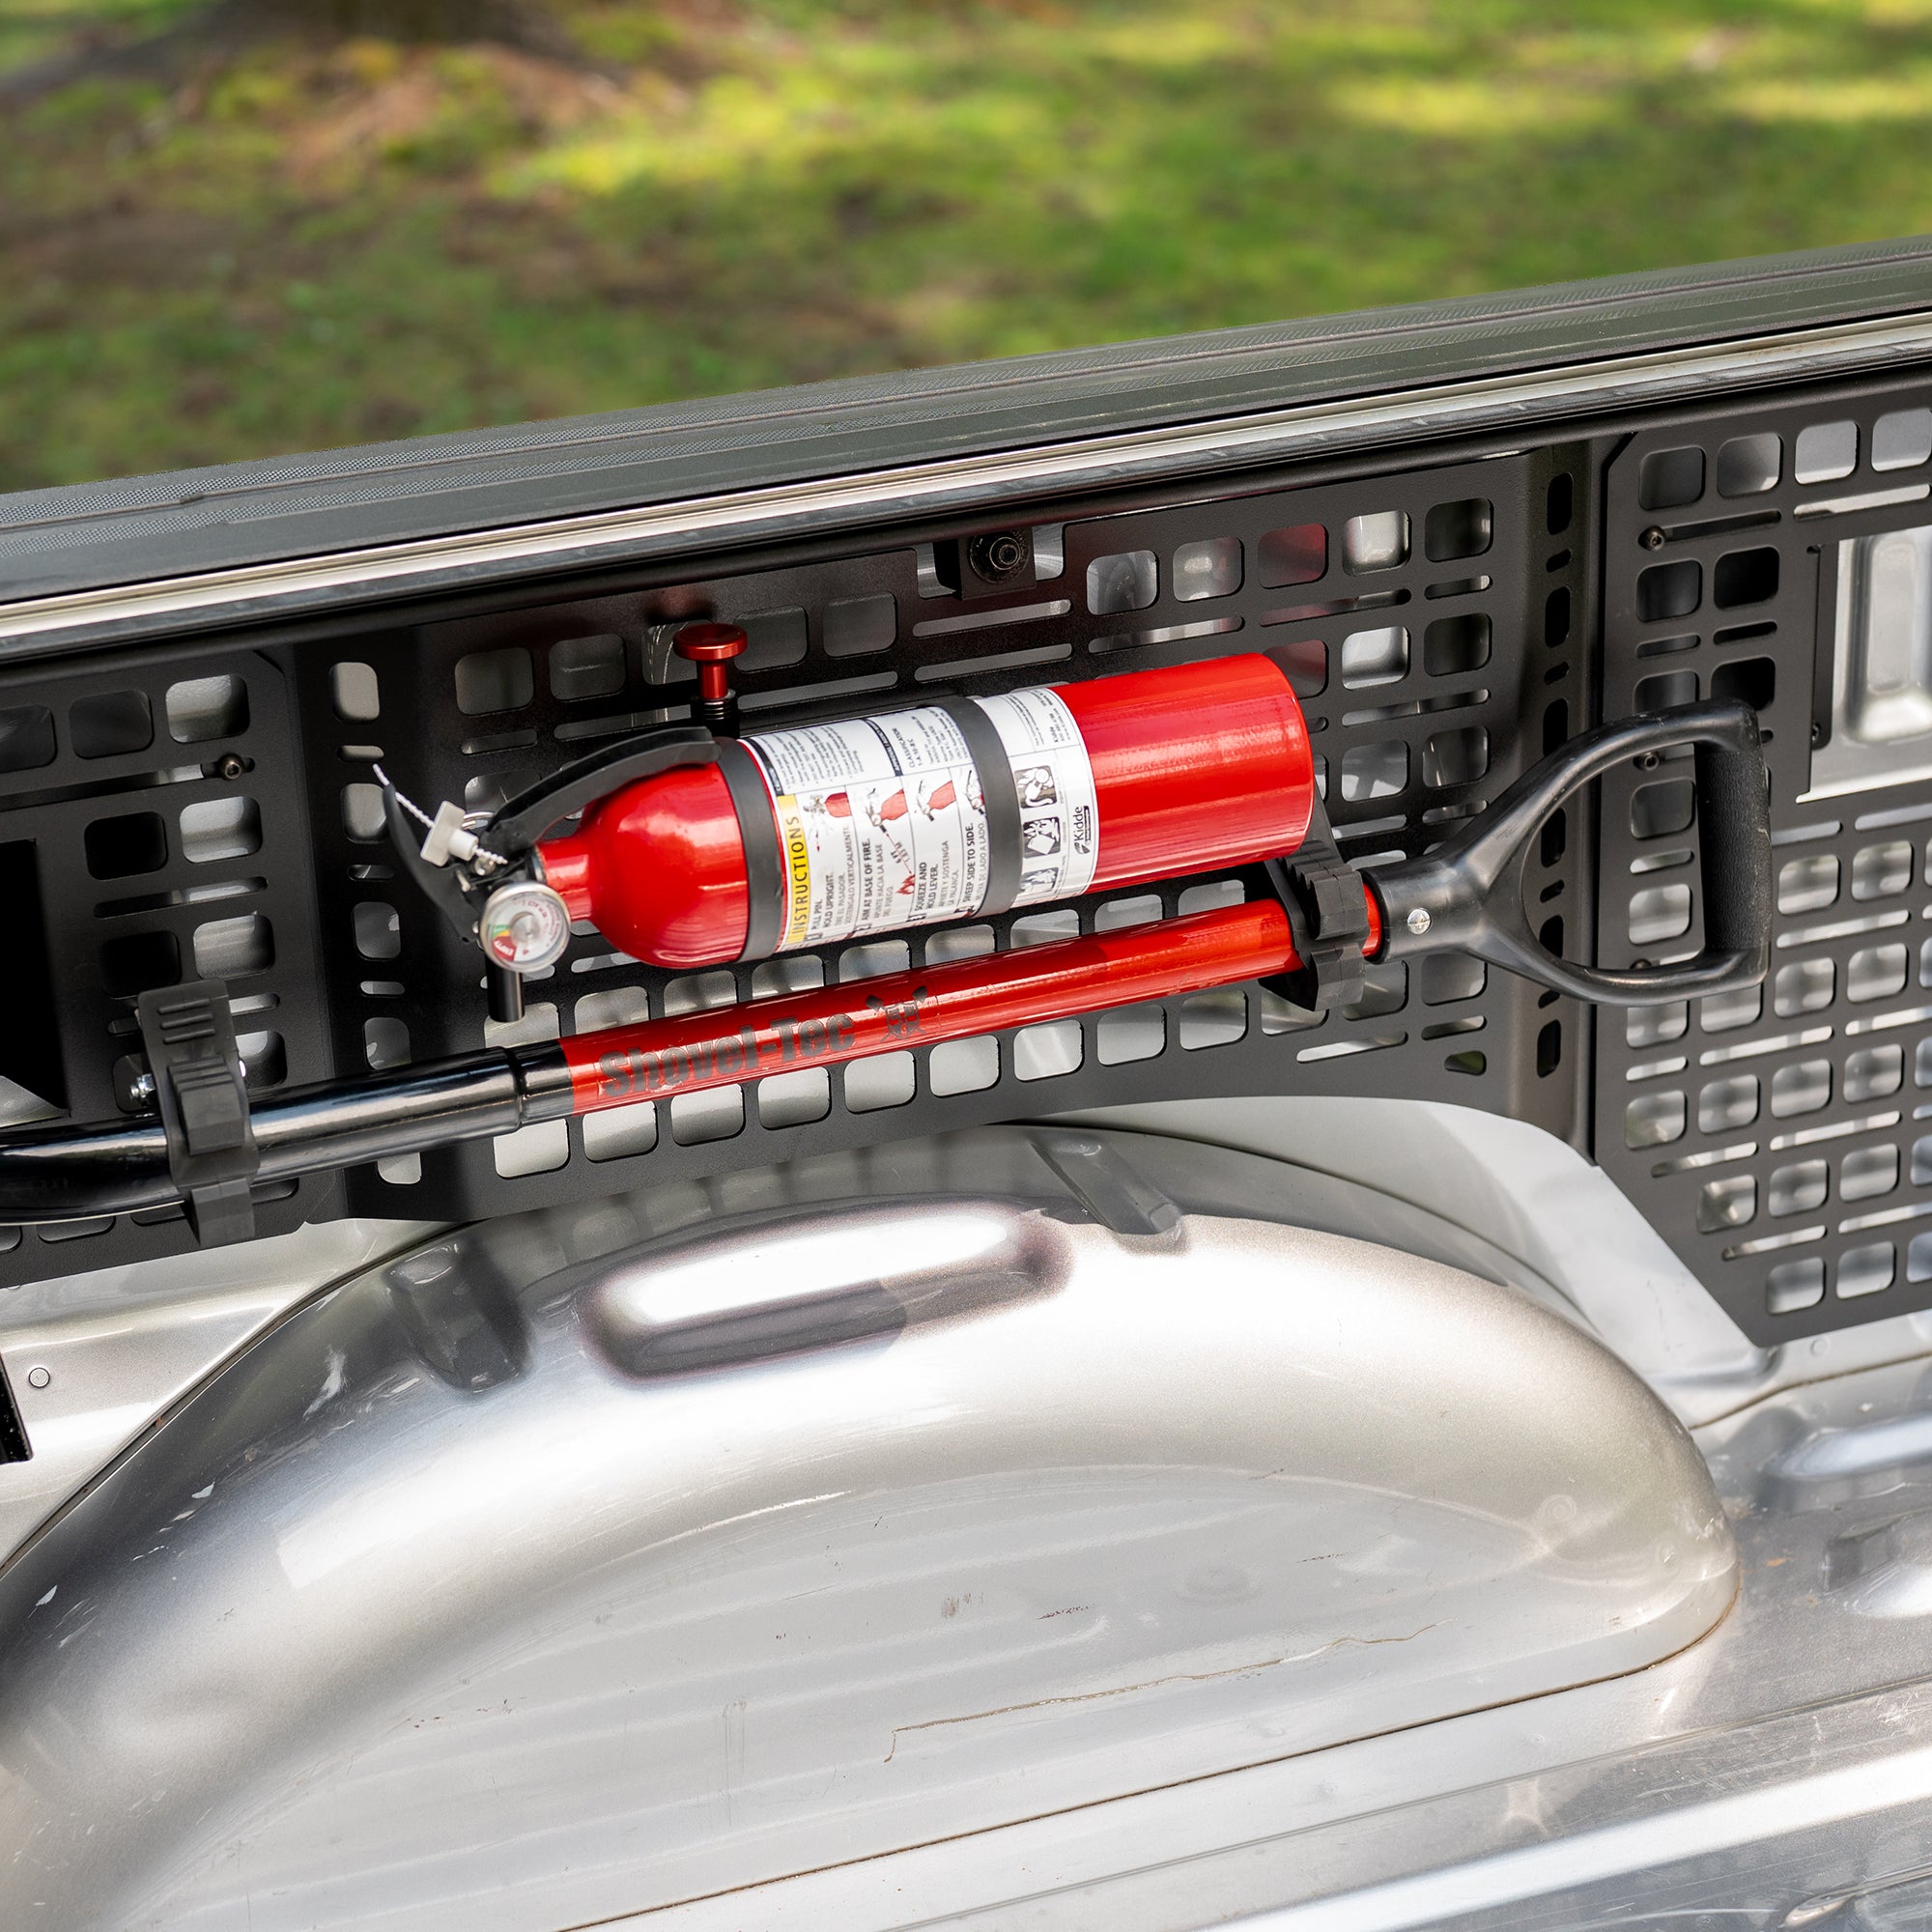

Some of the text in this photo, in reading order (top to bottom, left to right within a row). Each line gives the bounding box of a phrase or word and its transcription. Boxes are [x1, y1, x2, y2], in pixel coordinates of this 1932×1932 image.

[1072, 807, 1085, 841] Kidde
[966, 822, 975, 846] SIDE.
[862, 838, 871, 861] FIRE.
[875, 844, 884, 863] BASE
[967, 849, 976, 861] TO
[787, 815, 808, 934] INSTRUCTIONS
[865, 863, 873, 874] OF
[967, 862, 976, 880] SIDE
[865, 876, 873, 896] BASE
[963, 882, 974, 903] SWEEP
[915, 882, 927, 911] SQUEEZE
[928, 892, 937, 909] HOLD
[812, 915, 822, 930] PULL
[825, 911, 834, 928] HOLD
[862, 908, 871, 921] AIM
[493, 939, 514, 956] EMPTY
[596, 1012, 856, 1099] Shovel-Tec
